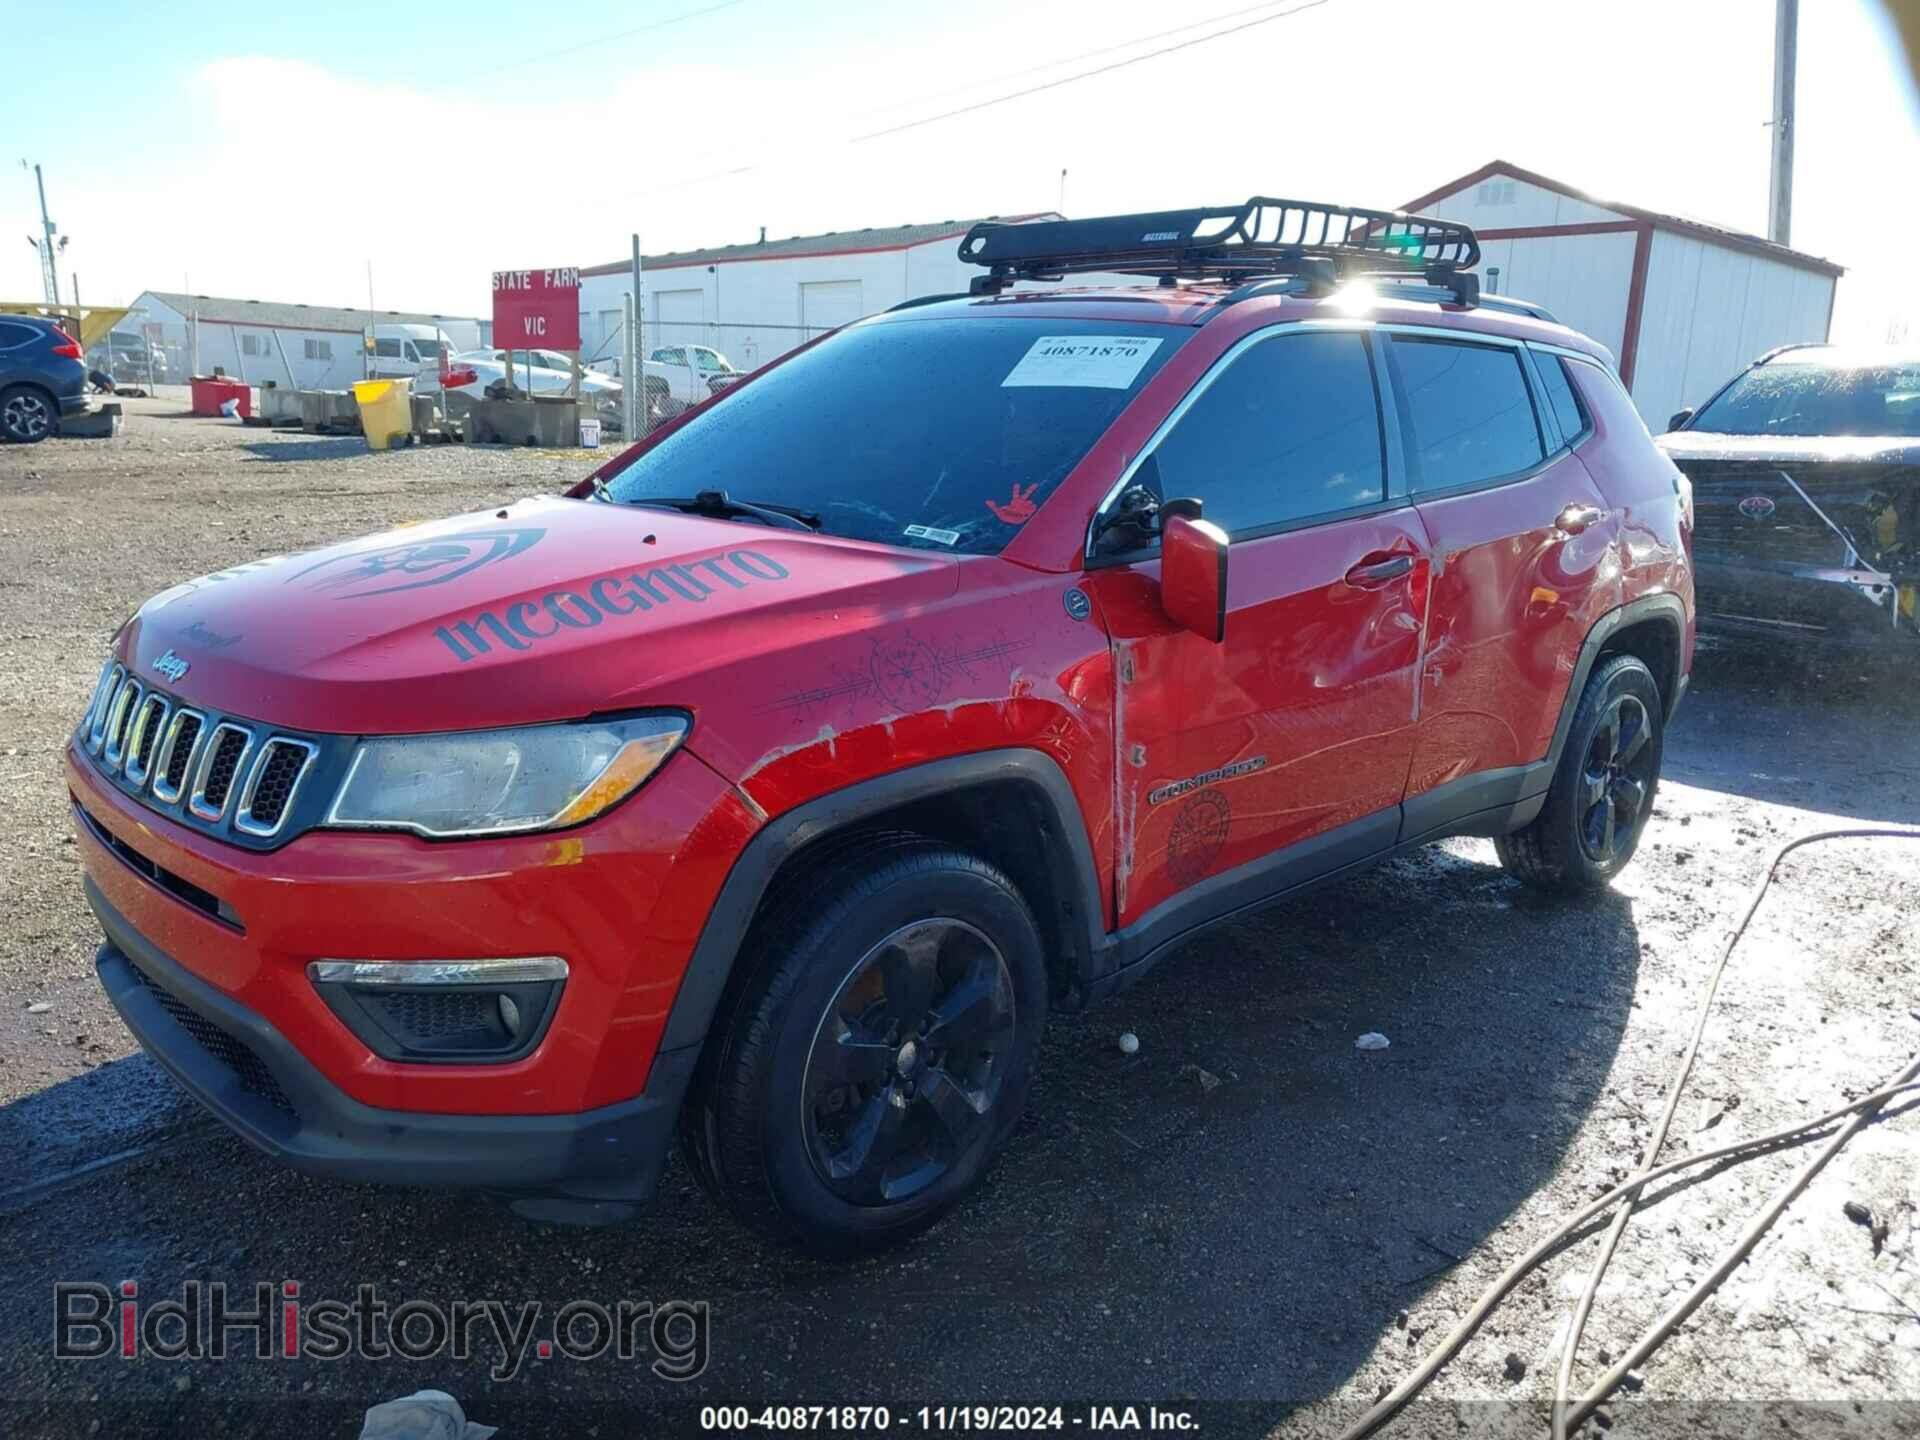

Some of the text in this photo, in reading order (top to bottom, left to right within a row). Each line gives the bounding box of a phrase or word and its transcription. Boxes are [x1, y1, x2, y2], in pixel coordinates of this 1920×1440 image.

[492, 267, 579, 291] STATE FARM
[524, 316, 546, 336] VIC
[1040, 346, 1138, 357] 40871870
[152, 648, 190, 684] Jeep
